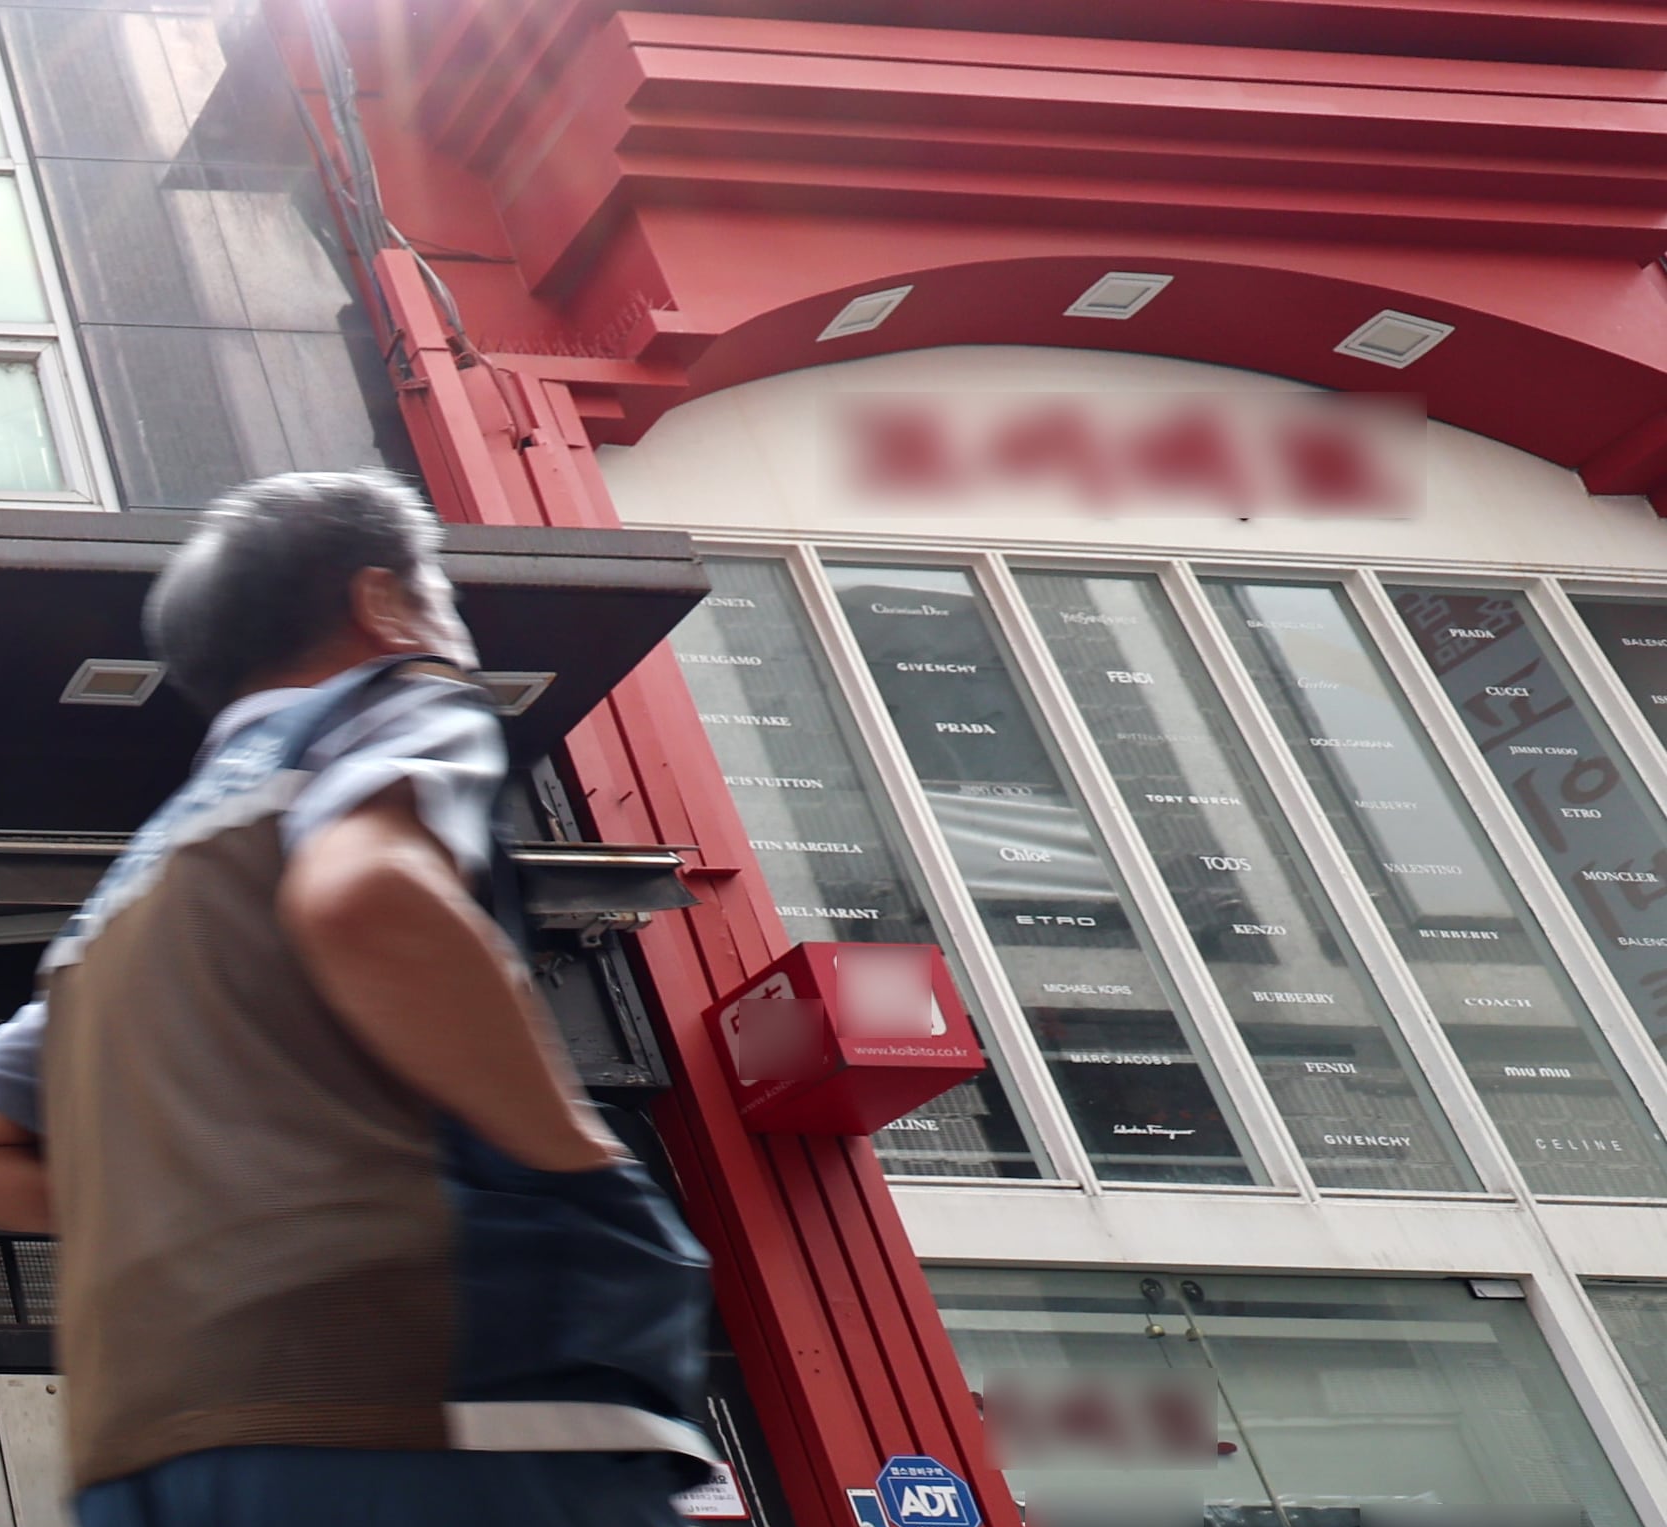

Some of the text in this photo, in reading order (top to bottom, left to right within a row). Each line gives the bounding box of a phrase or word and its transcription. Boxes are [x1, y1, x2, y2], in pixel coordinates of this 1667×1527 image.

[1448, 627, 1496, 639] PRADA
[896, 661, 977, 674] GIVENCHY
[1106, 670, 1154, 685] FENDI
[733, 714, 792, 727] MIYAKE
[934, 721, 997, 735] PRADA
[1508, 744, 1579, 756] JIMMY CHOO
[754, 776, 824, 789] VUITTON
[1145, 793, 1242, 806] TORY BURCH
[1560, 807, 1602, 819] ETRO
[784, 840, 864, 854] MARGIELA
[1382, 862, 1463, 875] VALENTINO
[1581, 869, 1659, 883] MONCLER
[814, 907, 881, 920] MARANT
[1015, 915, 1097, 927] ETRO
[1232, 923, 1287, 936] KENZO
[1418, 929, 1500, 940] BURBERRY
[1042, 983, 1133, 996] MICHAEL KORS
[1251, 991, 1335, 1004] BURBERRY
[1464, 997, 1532, 1009] COACH
[854, 1044, 968, 1058] www.koibito.co.kr
[1070, 1054, 1172, 1065] MARC JACOBS
[1303, 1061, 1358, 1074] FENDI
[1323, 1134, 1411, 1148] GIVENCHY
[1535, 1138, 1623, 1152] CELINE
[900, 1485, 959, 1518] ADT
